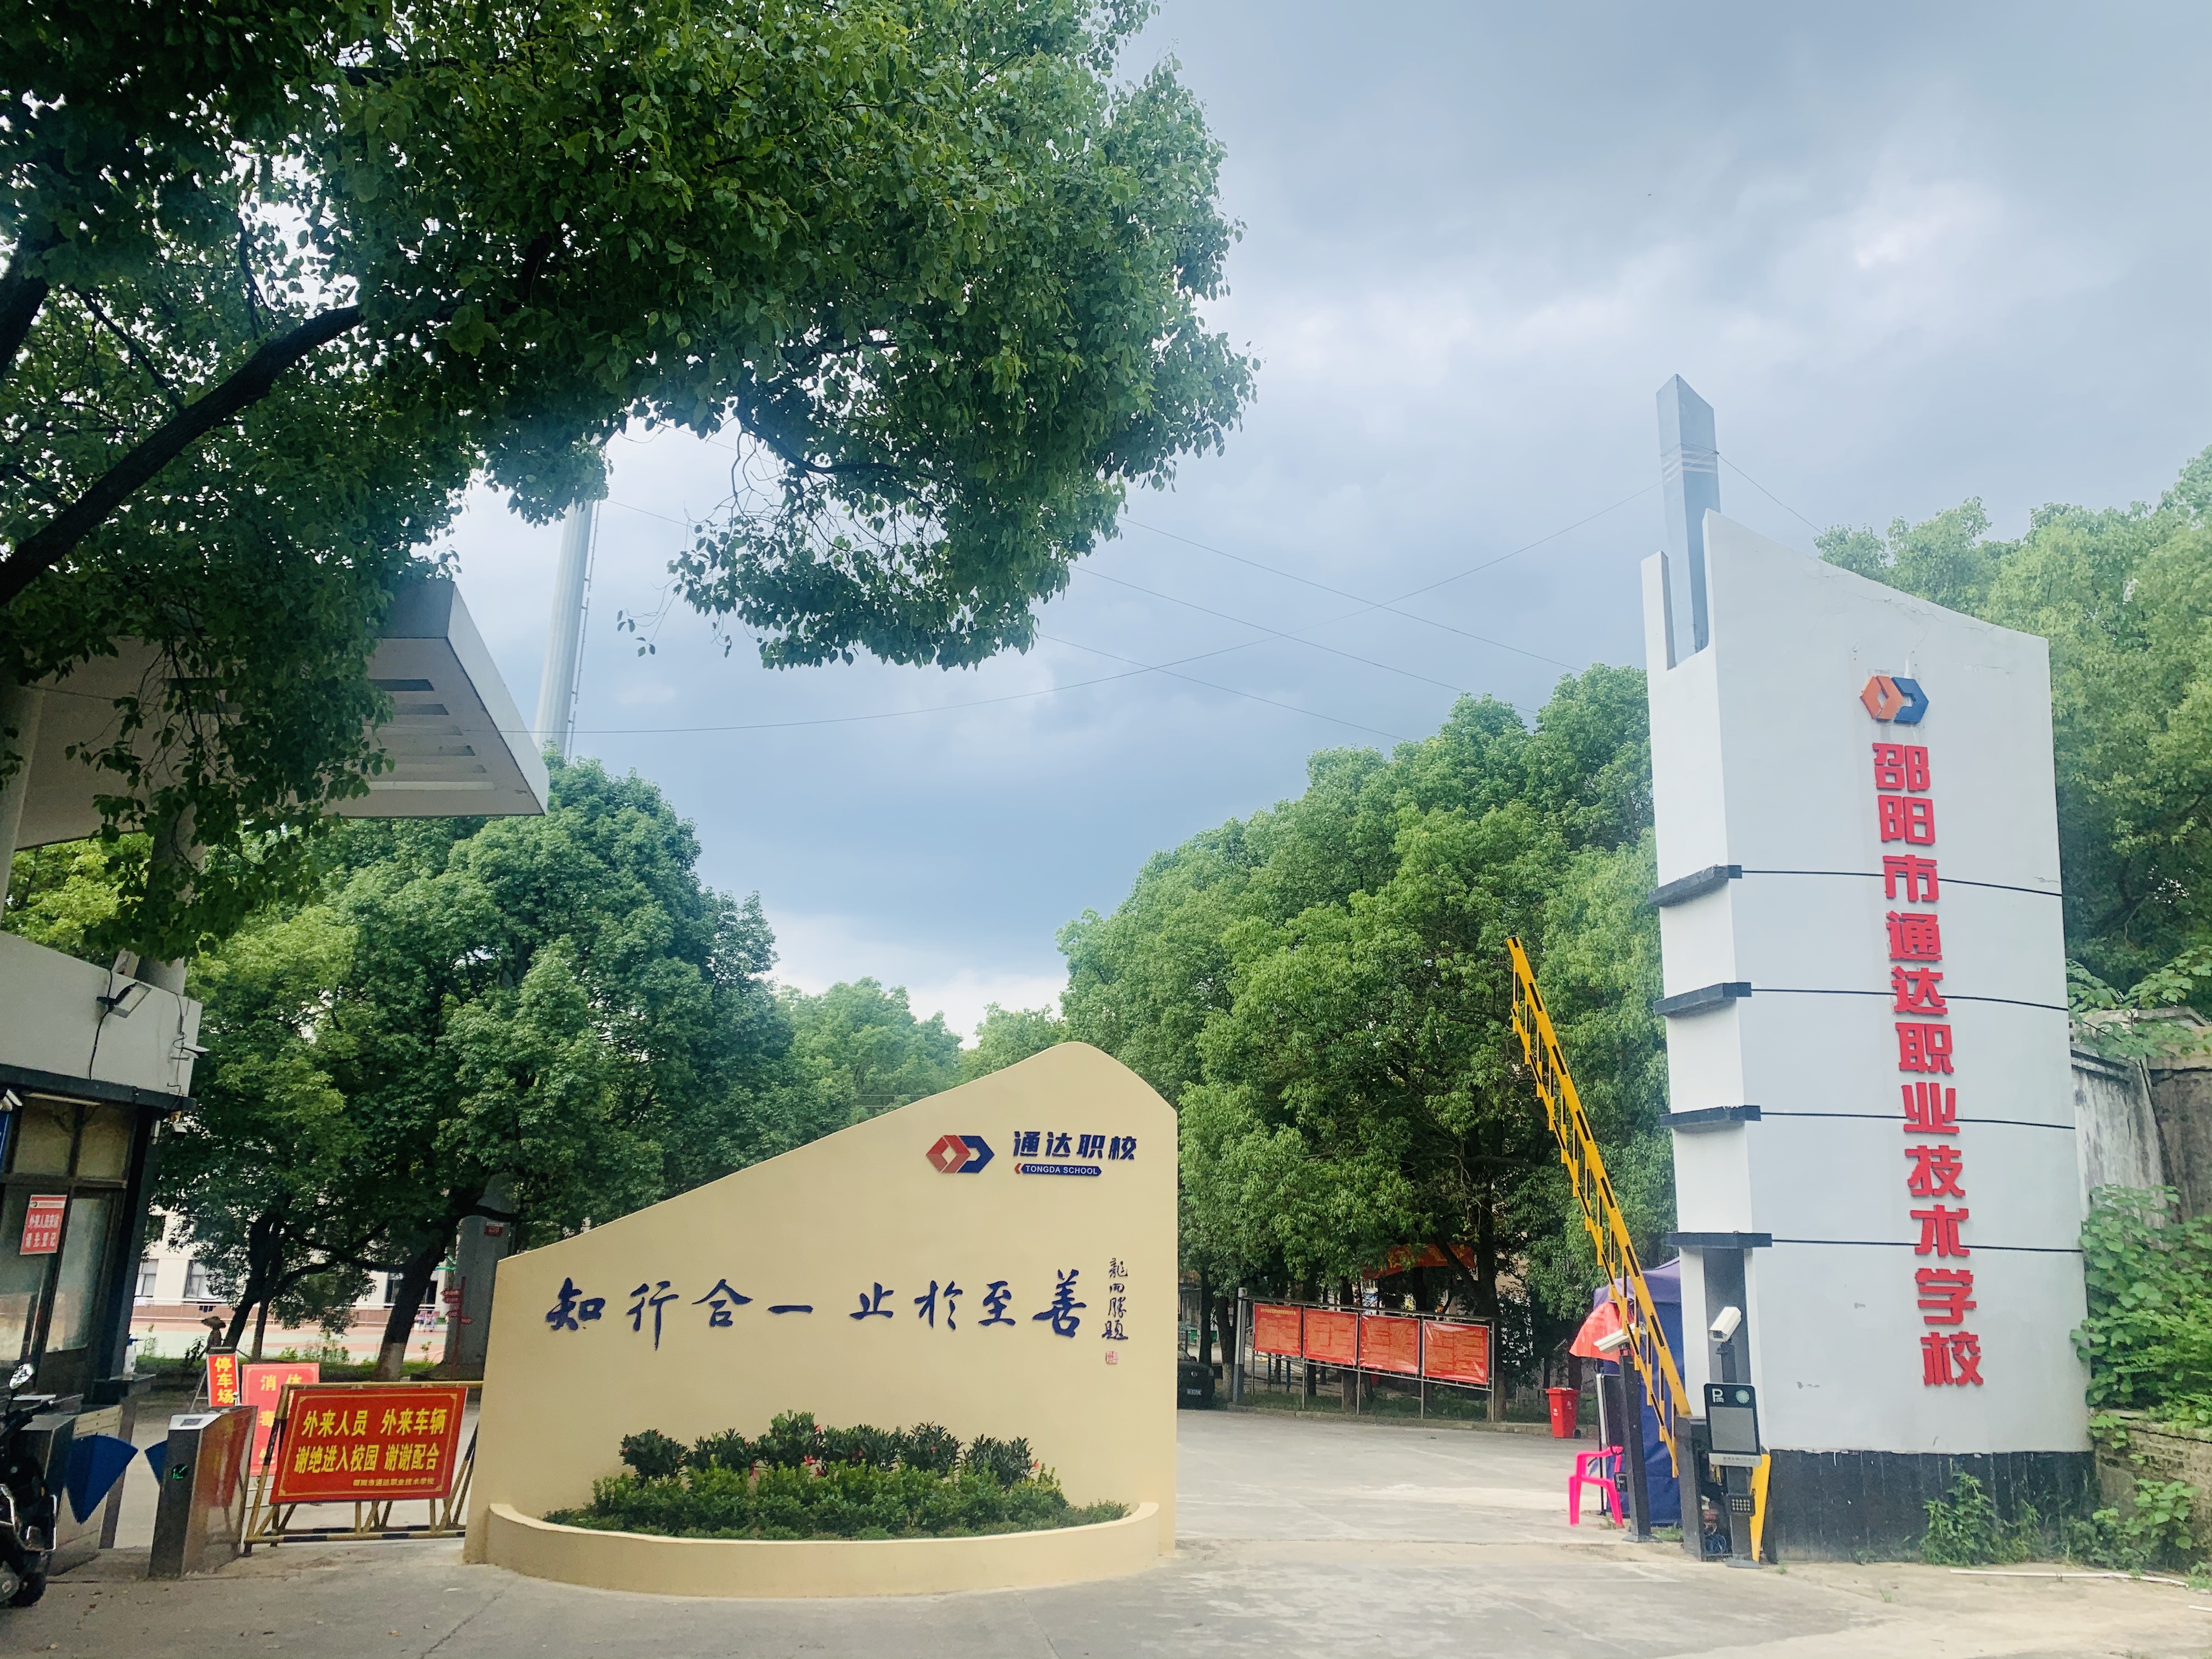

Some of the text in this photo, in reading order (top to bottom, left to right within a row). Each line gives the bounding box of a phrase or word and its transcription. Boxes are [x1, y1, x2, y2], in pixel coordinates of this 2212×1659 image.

[1872, 742, 1984, 1385] 邵阳市通达职业技术学校
[1013, 1131, 1137, 1160] 通达职校
[1025, 1165, 1098, 1175] TONGDA SCHOOL
[215, 1357, 234, 1404] 停车场
[301, 1408, 448, 1438] 外来人员 外来车辆
[294, 1442, 439, 1474] 谢绝进入校园 谢谢配合
